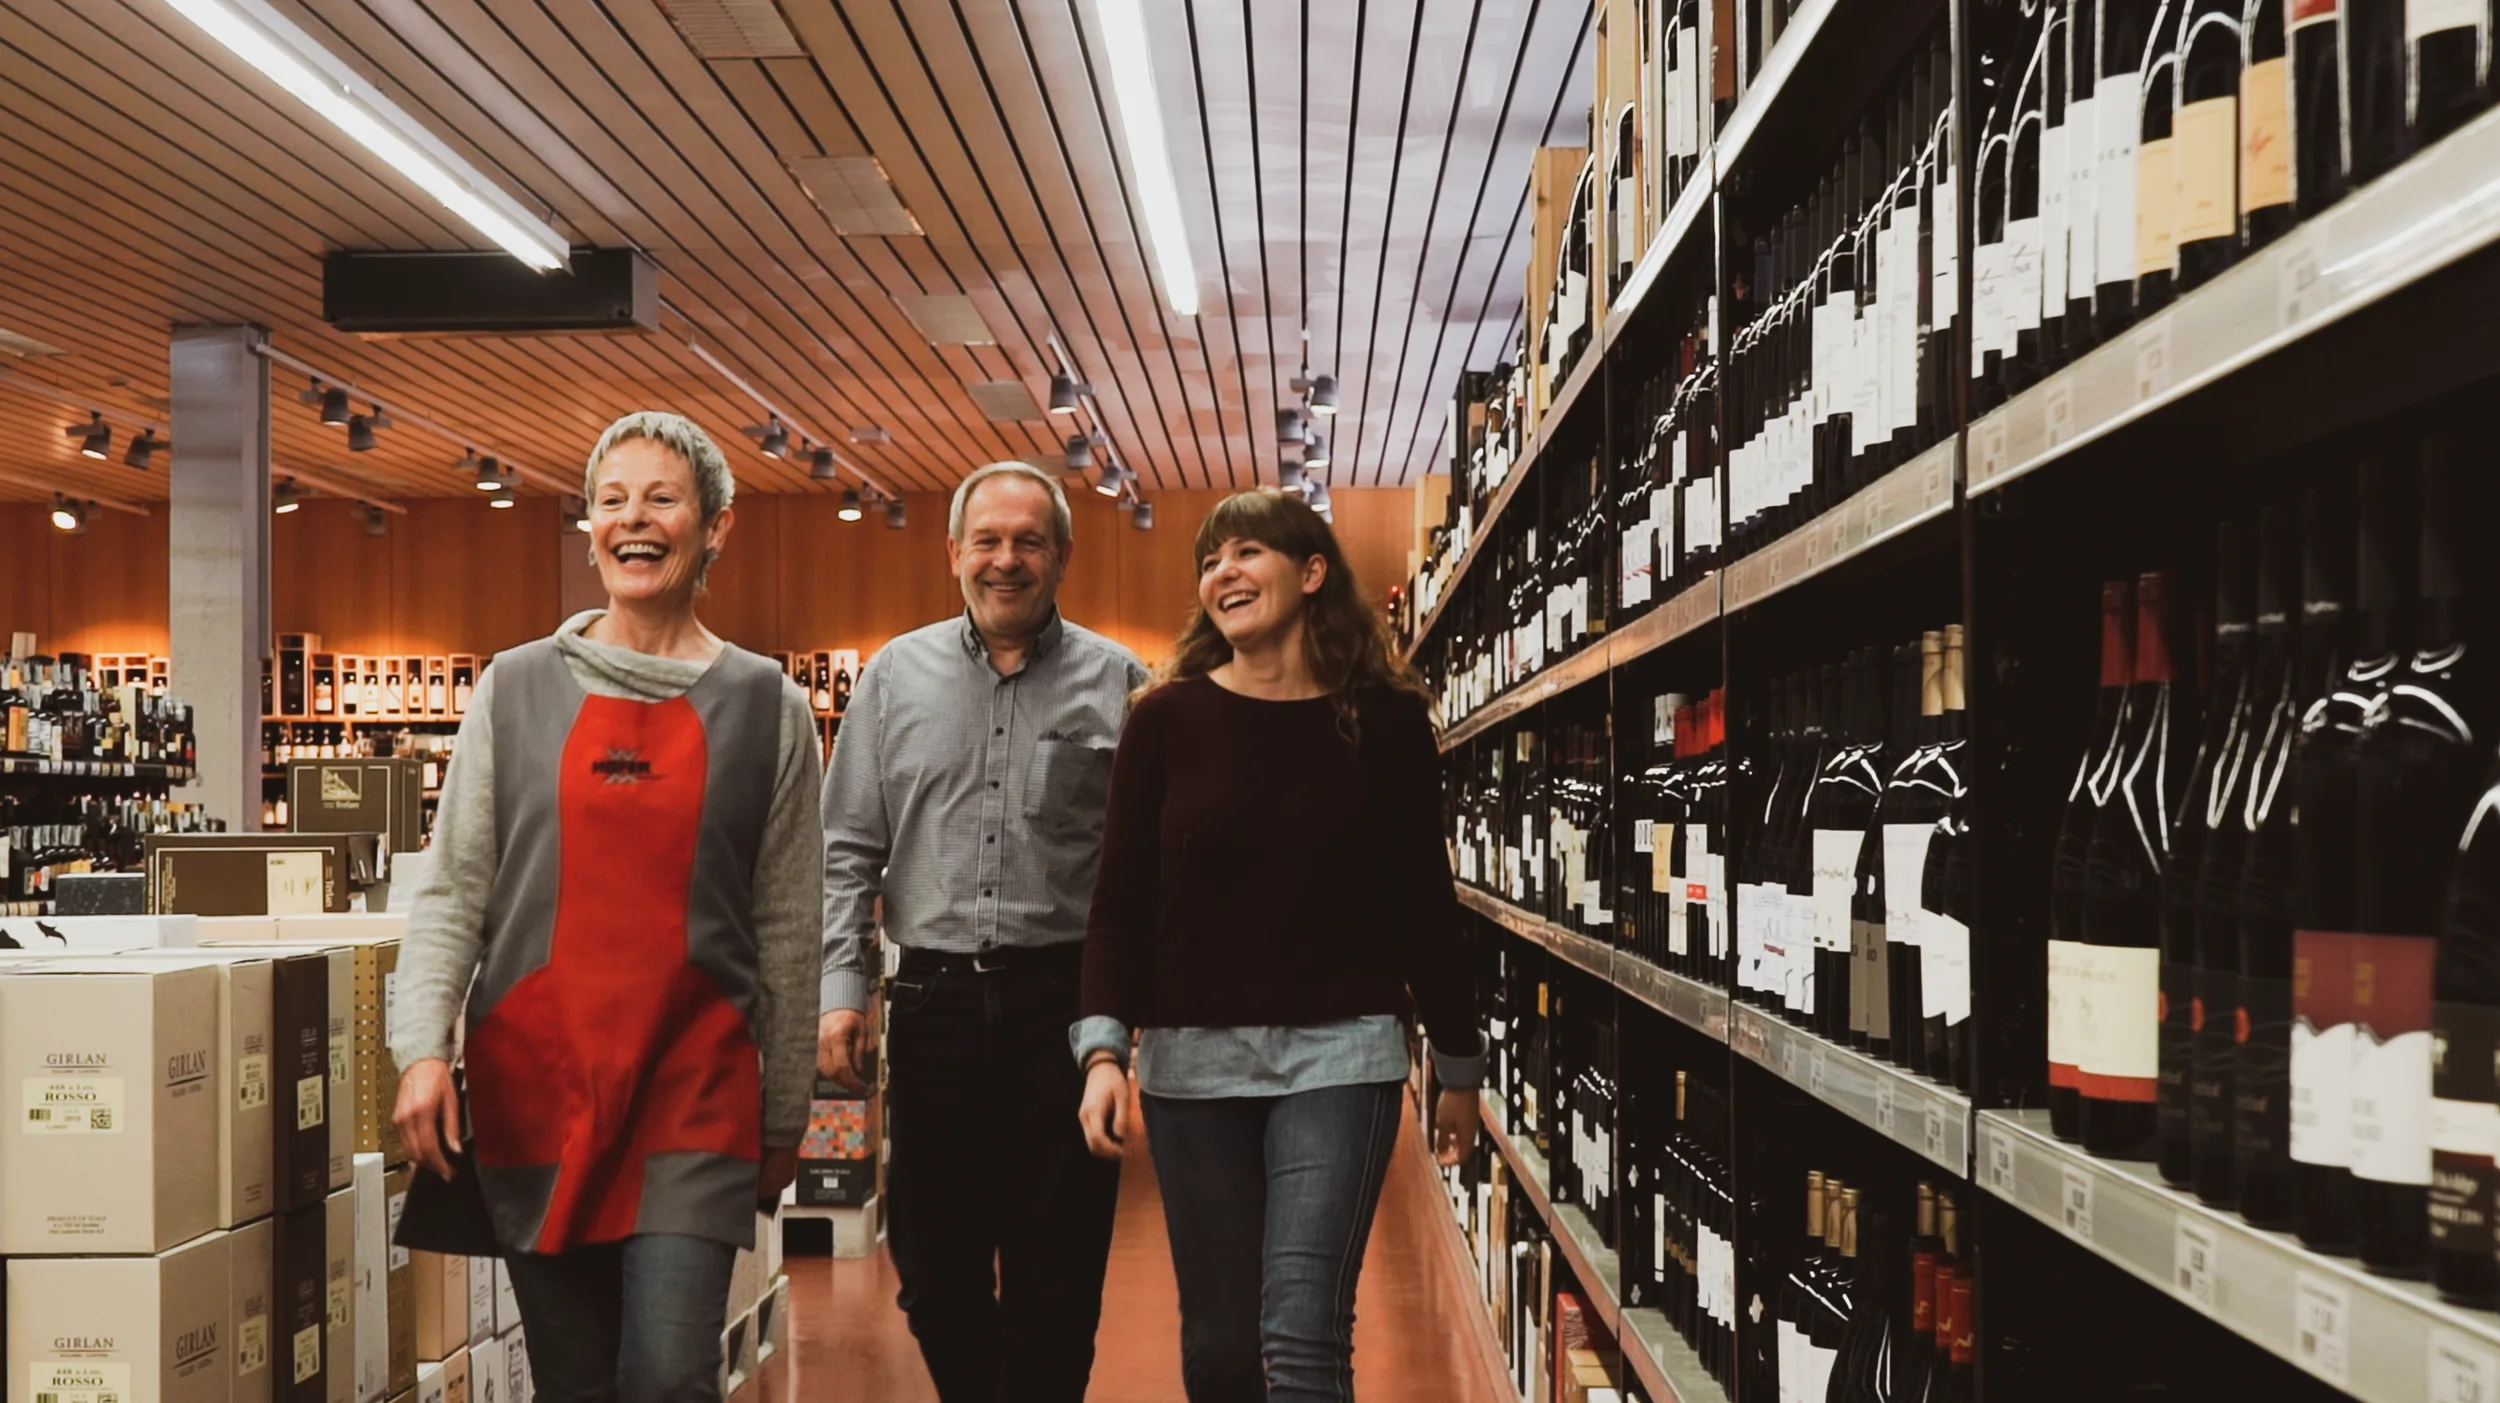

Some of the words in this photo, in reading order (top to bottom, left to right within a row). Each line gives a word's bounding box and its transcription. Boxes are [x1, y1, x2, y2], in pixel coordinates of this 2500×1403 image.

[46, 1052, 107, 1065] GIRLAN
[168, 1050, 207, 1080] GIRLAN
[45, 1092, 97, 1102] ROSSO
[54, 1337, 115, 1349] GIRLAN
[175, 1321, 217, 1360] GIRLAN
[52, 1376, 104, 1387] ROSSO
